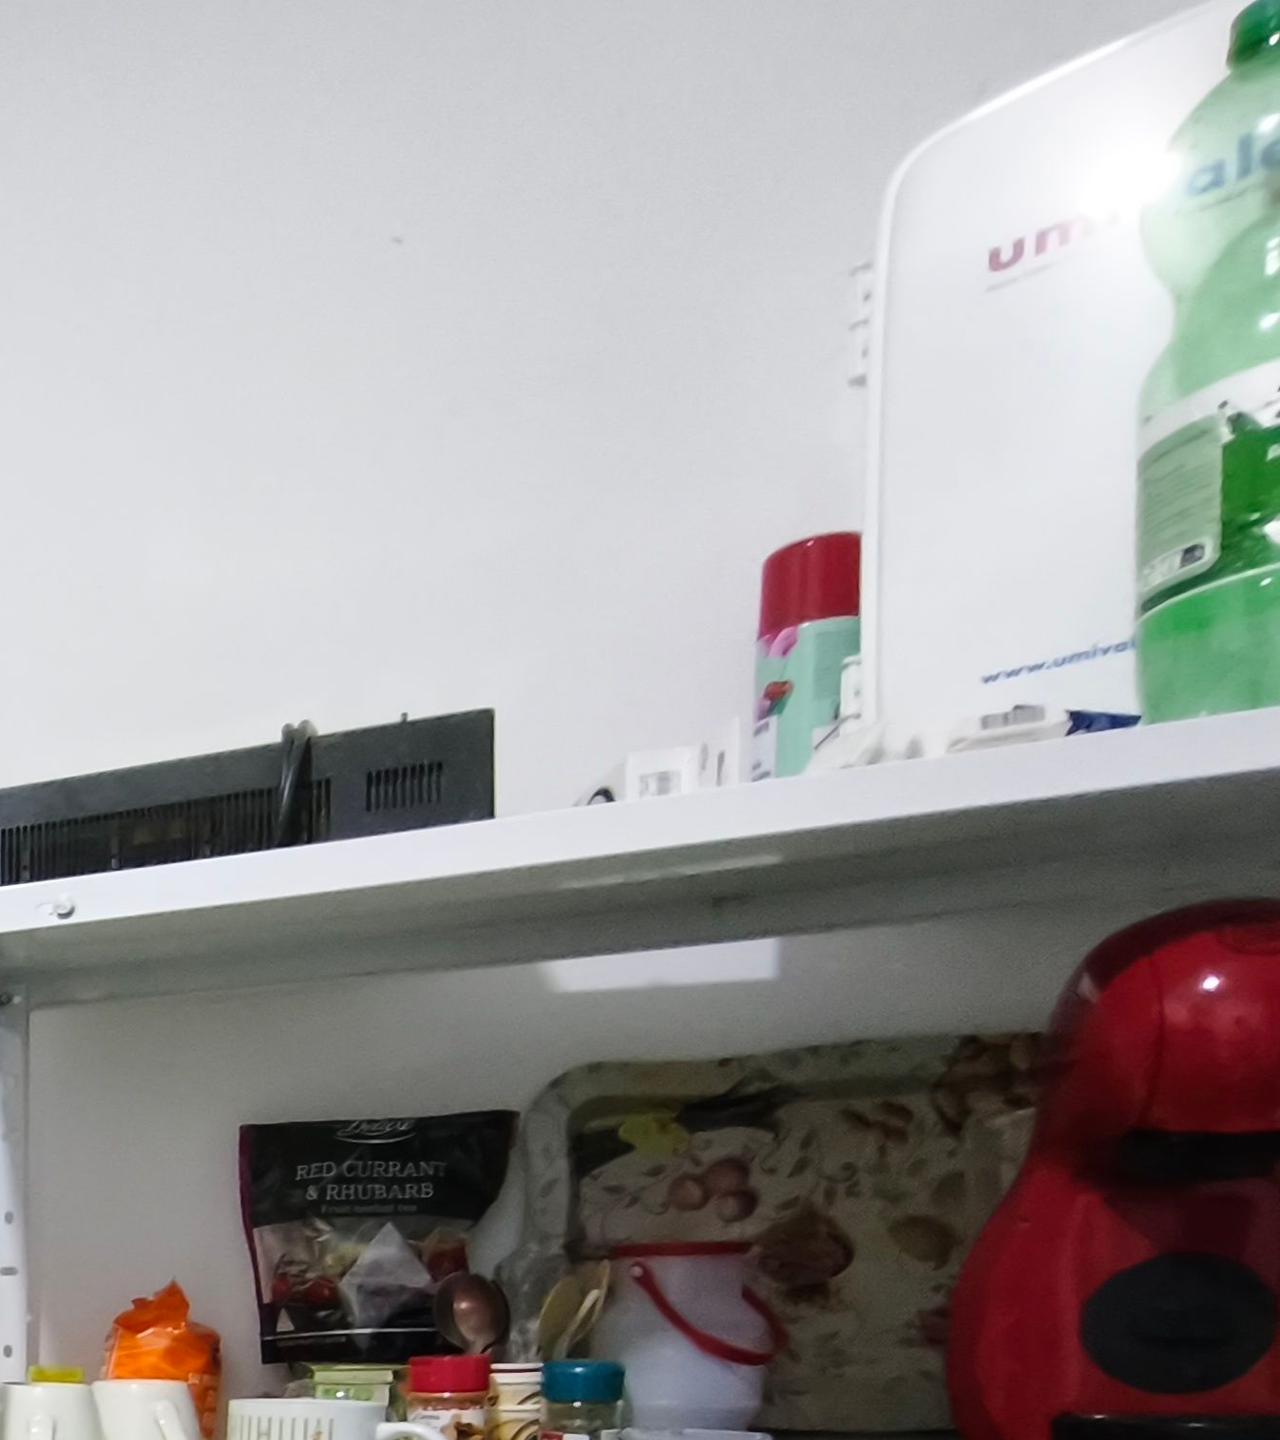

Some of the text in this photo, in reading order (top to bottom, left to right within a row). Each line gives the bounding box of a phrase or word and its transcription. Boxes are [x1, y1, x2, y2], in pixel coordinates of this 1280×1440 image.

[295, 1160, 448, 1180] RED CURRANT
[305, 1182, 435, 1201] & RHUBARB
